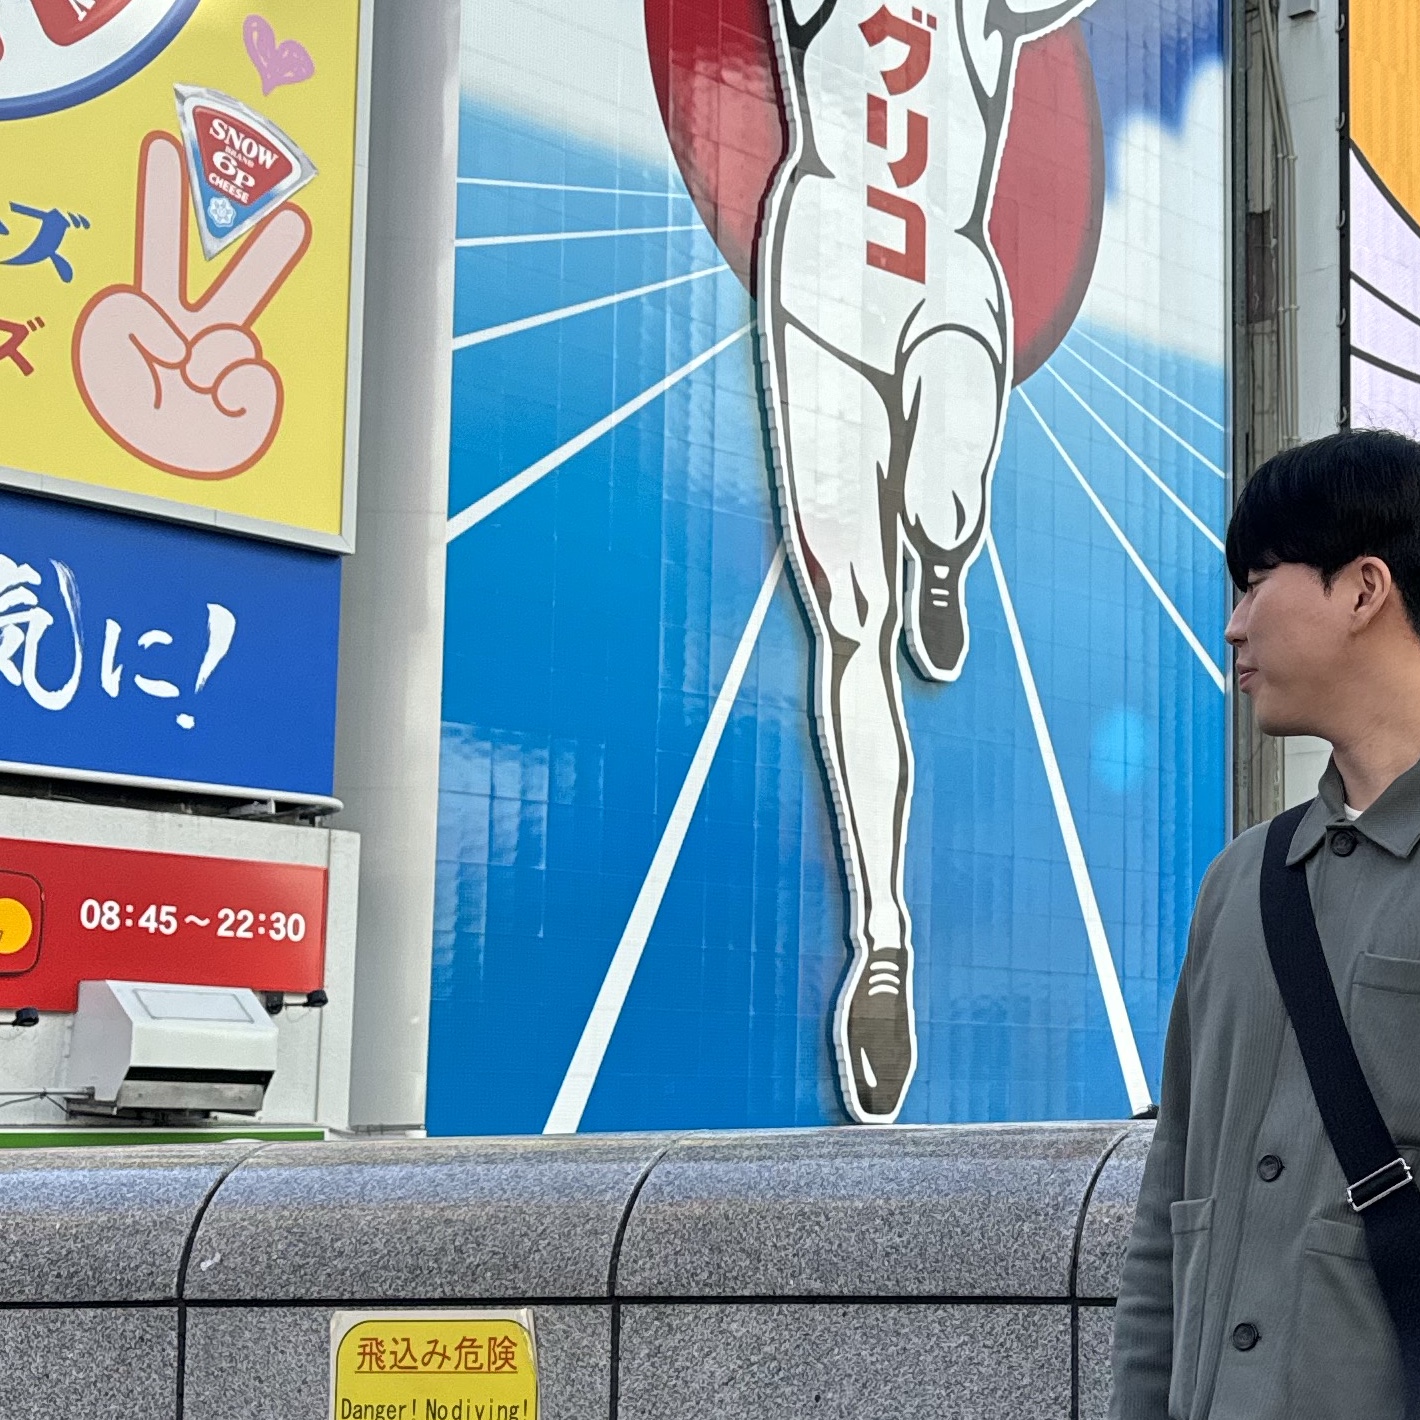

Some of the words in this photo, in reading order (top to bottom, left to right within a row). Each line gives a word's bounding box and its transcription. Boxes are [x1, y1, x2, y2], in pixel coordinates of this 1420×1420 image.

[209, 119, 279, 169] SNOW
[225, 146, 255, 168] BRAND
[858, 4, 937, 285] グリコ
[212, 151, 256, 188] 6P
[208, 173, 250, 204] CHEESE
[356, 1335, 518, 1371] 飛込み危険
